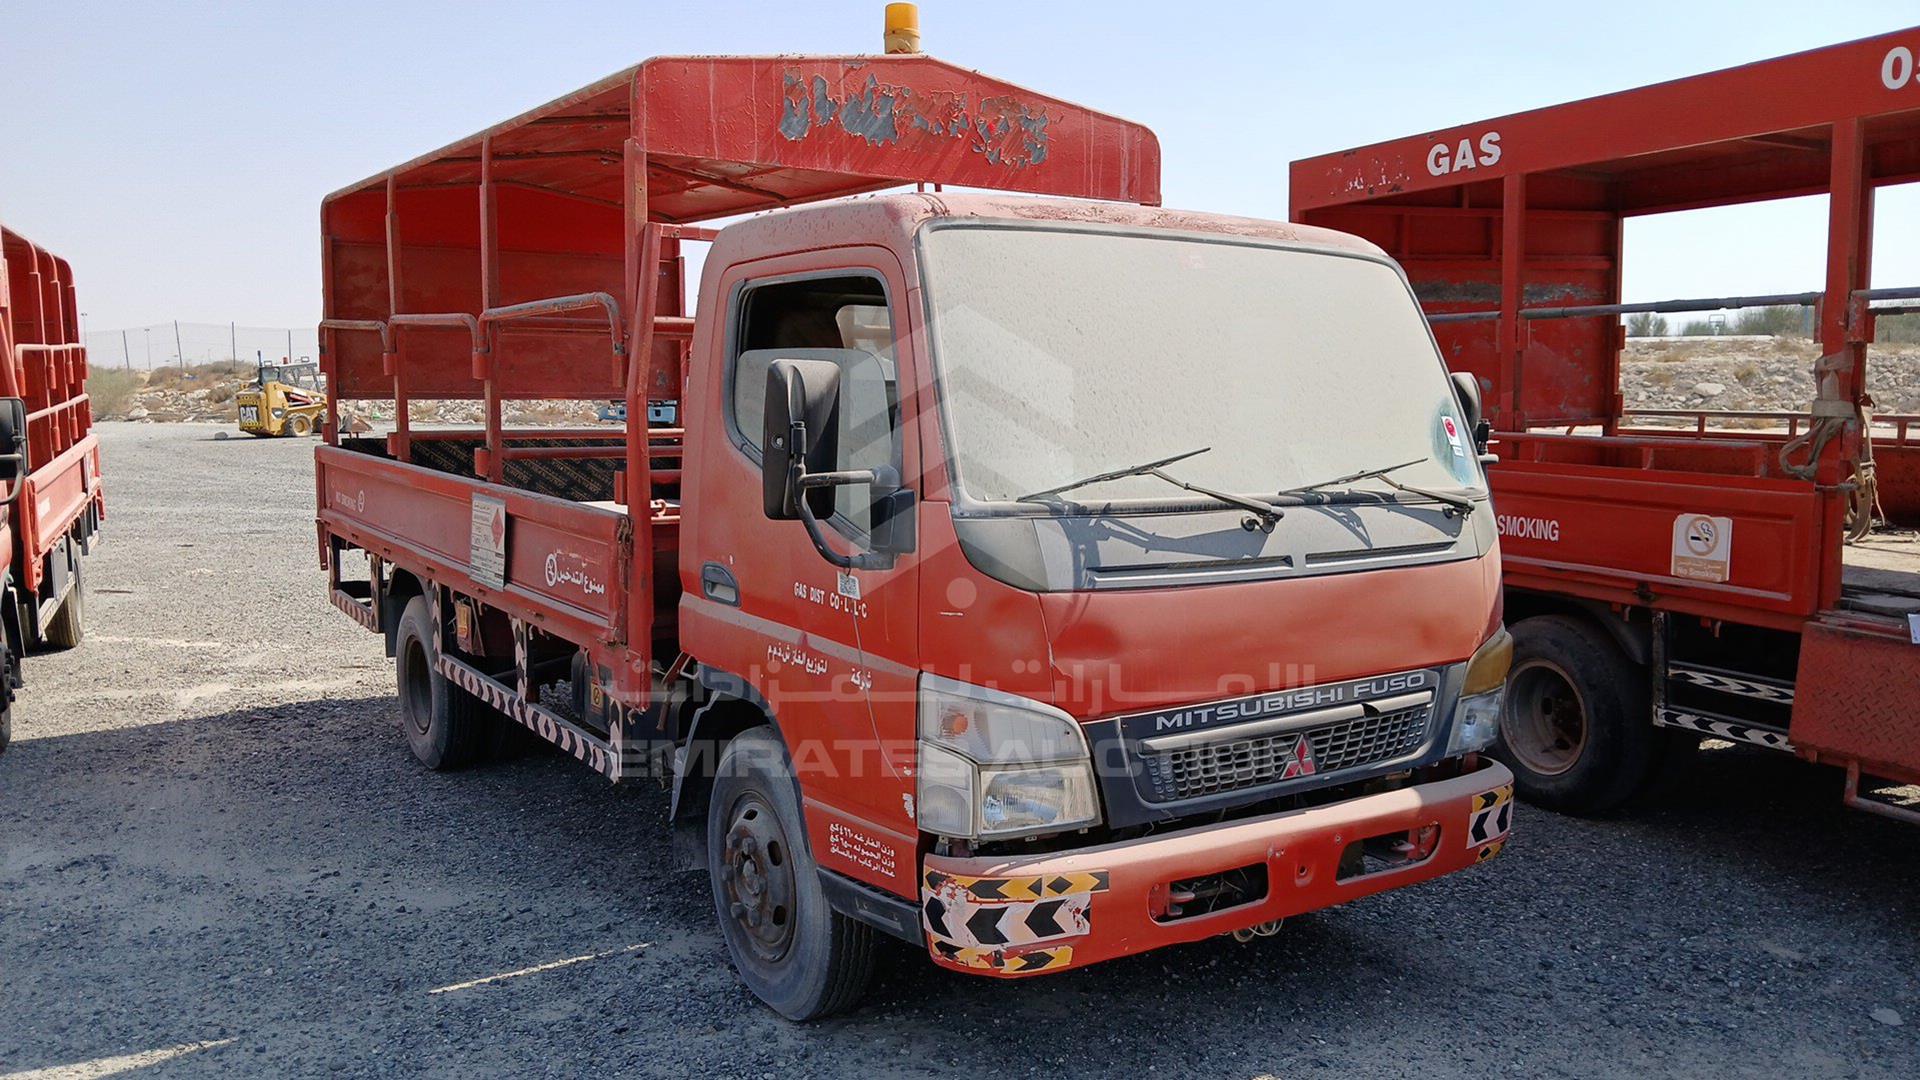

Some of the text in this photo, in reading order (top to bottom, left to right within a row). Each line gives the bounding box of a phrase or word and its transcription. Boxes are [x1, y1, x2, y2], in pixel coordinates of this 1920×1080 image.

[1881, 46, 1920, 89] 0
[1427, 132, 1502, 176] GAS
[240, 406, 258, 424] CAT
[1497, 514, 1560, 542] SMOKING
[556, 566, 605, 594] ممنوع التدخين
[793, 582, 808, 599] GAS
[809, 586, 826, 605] DIST
[805, 656, 828, 675] لتوزيع
[850, 666, 873, 690] شركة
[1155, 671, 1426, 732] MITSUBISHI FUSO
